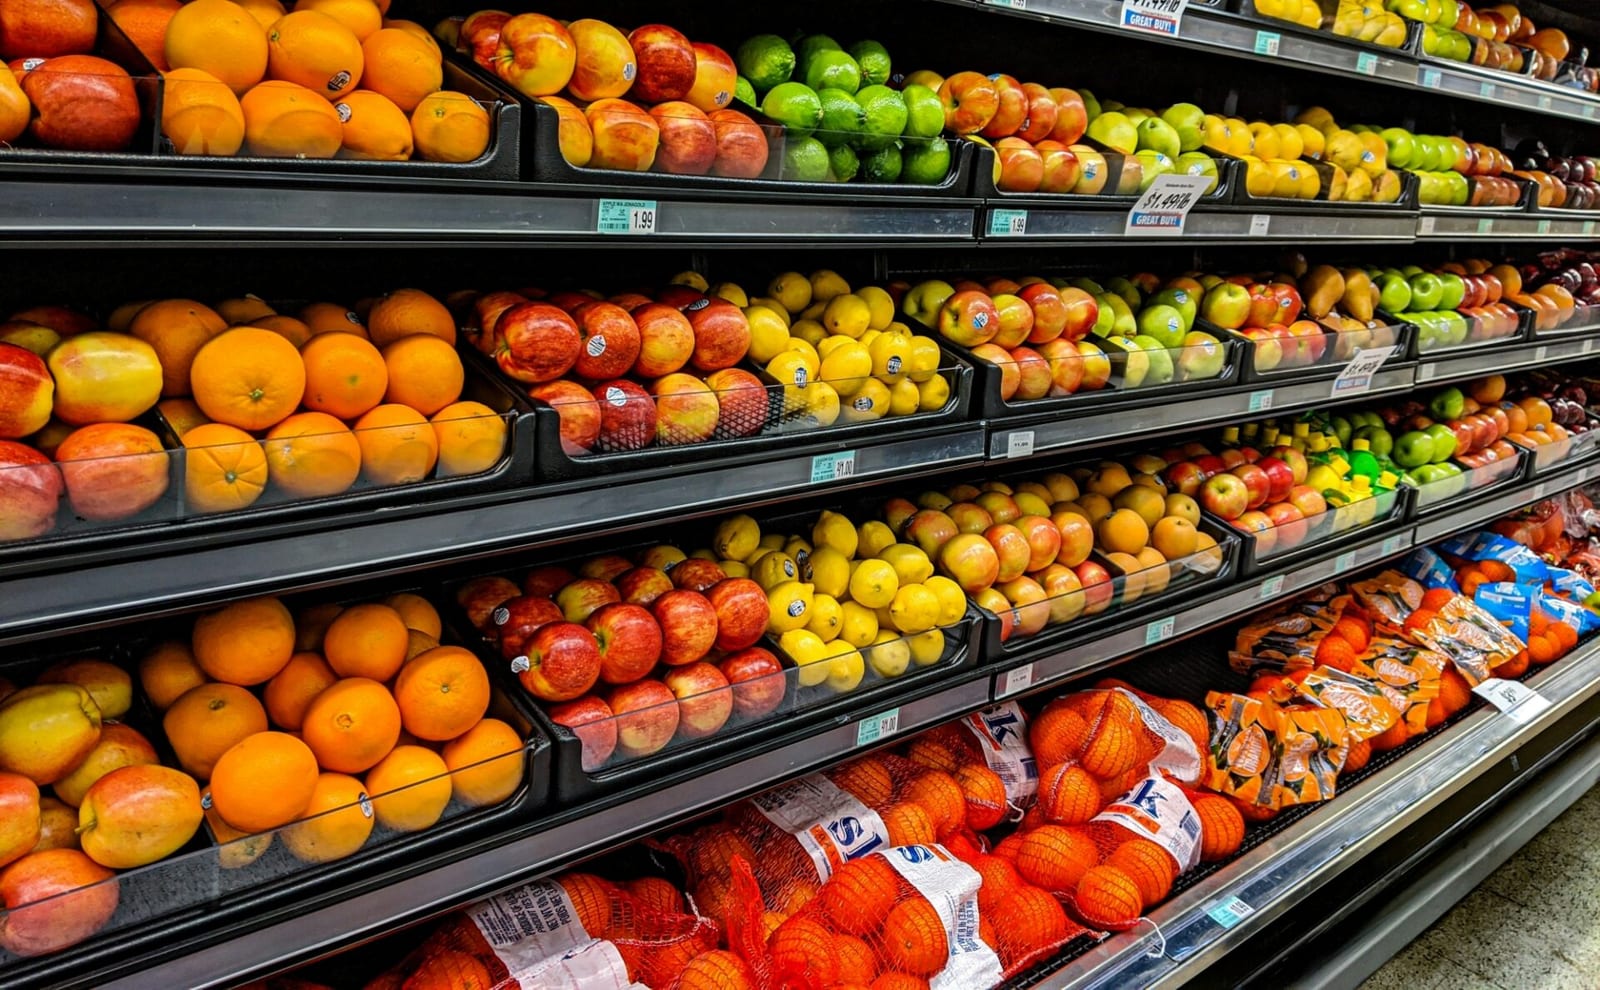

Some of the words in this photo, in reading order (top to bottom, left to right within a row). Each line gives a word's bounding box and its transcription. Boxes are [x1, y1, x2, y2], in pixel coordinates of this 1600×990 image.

[1130, 14, 1153, 27] GREAT
[1154, 19, 1171, 31] BUY!
[634, 210, 653, 229] 1.99
[1012, 217, 1025, 232] 1.99
[1136, 215, 1159, 225] GREAT
[1160, 215, 1178, 225] BUY!
[550, 894, 563, 907] NET
[541, 907, 554, 919] WT
[556, 905, 572, 926] POIDS
[516, 911, 535, 936] PRODUCE
[546, 917, 560, 931] NET
